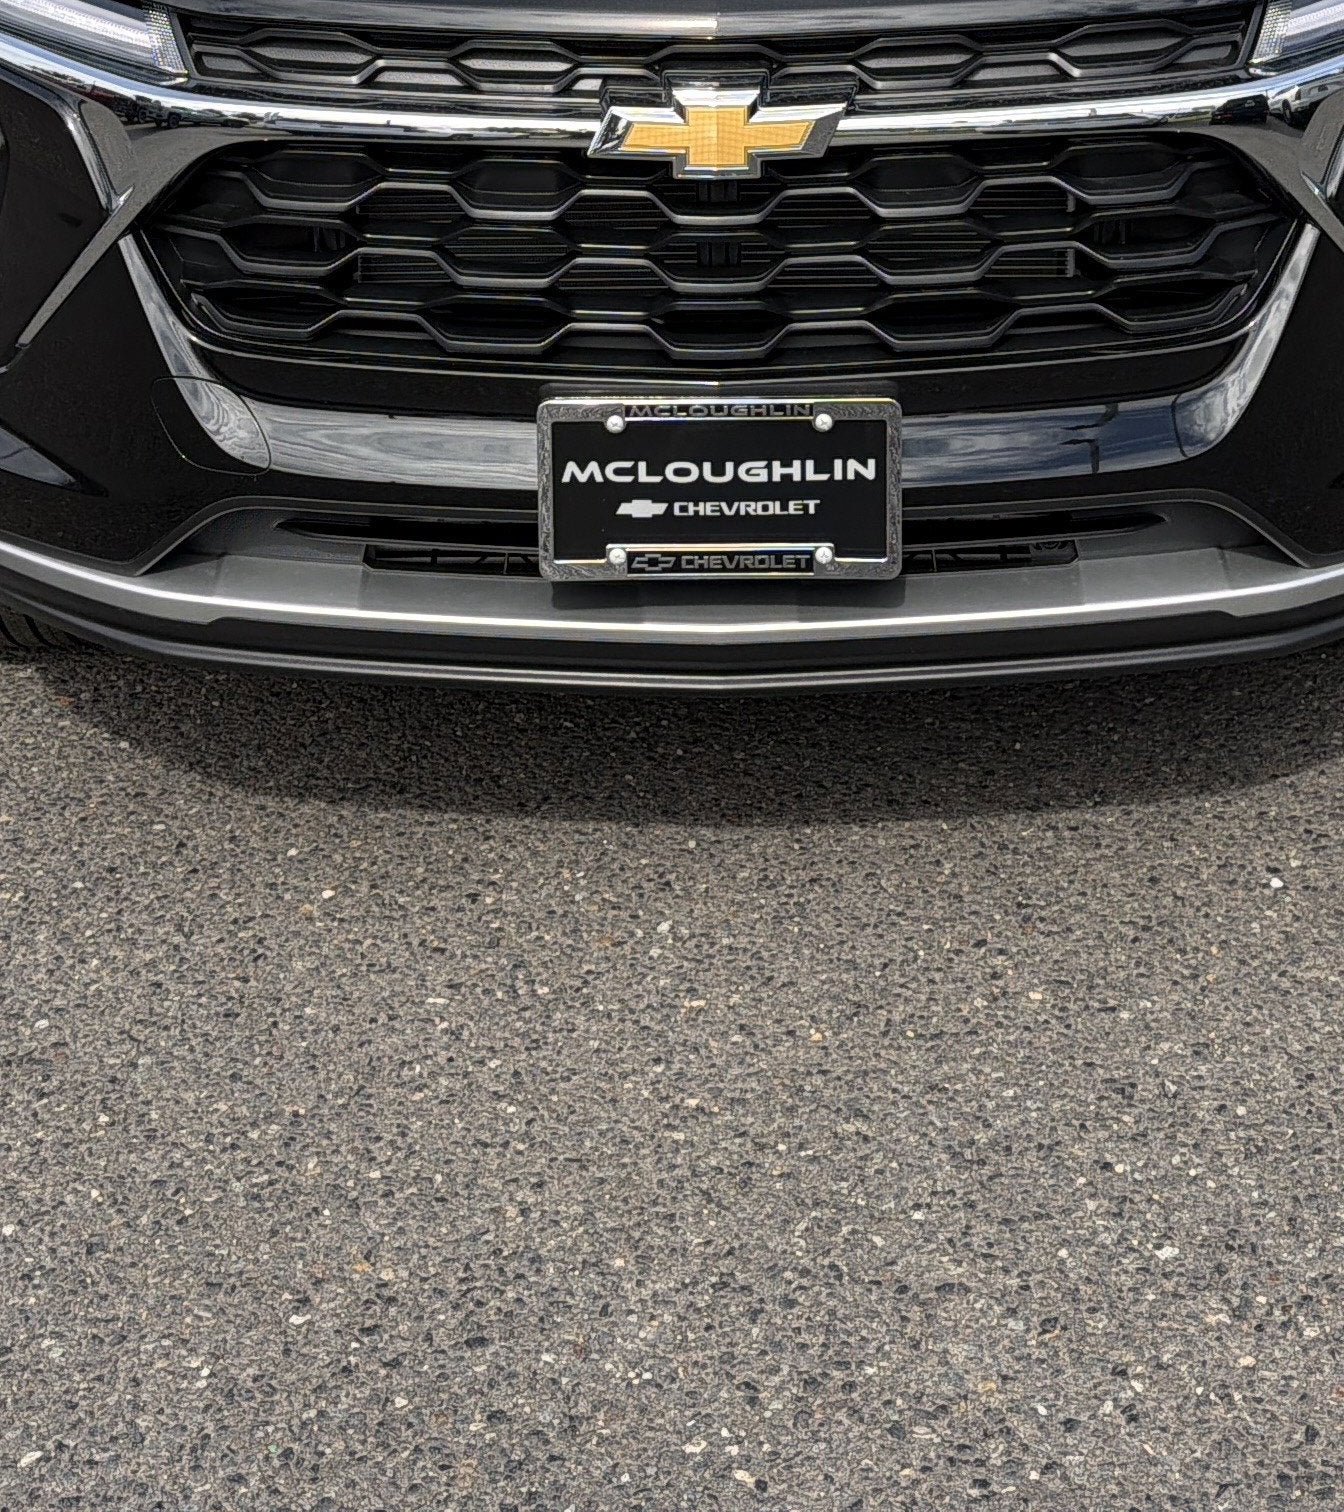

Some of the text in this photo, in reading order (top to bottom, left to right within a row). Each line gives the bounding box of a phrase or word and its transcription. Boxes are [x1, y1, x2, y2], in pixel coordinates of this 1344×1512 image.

[629, 404, 811, 417] MCLOUGHLIN
[561, 458, 876, 483] MCLOUGHLIN
[673, 499, 821, 516] CHEVROLET
[681, 554, 809, 570] CHEVROLET
